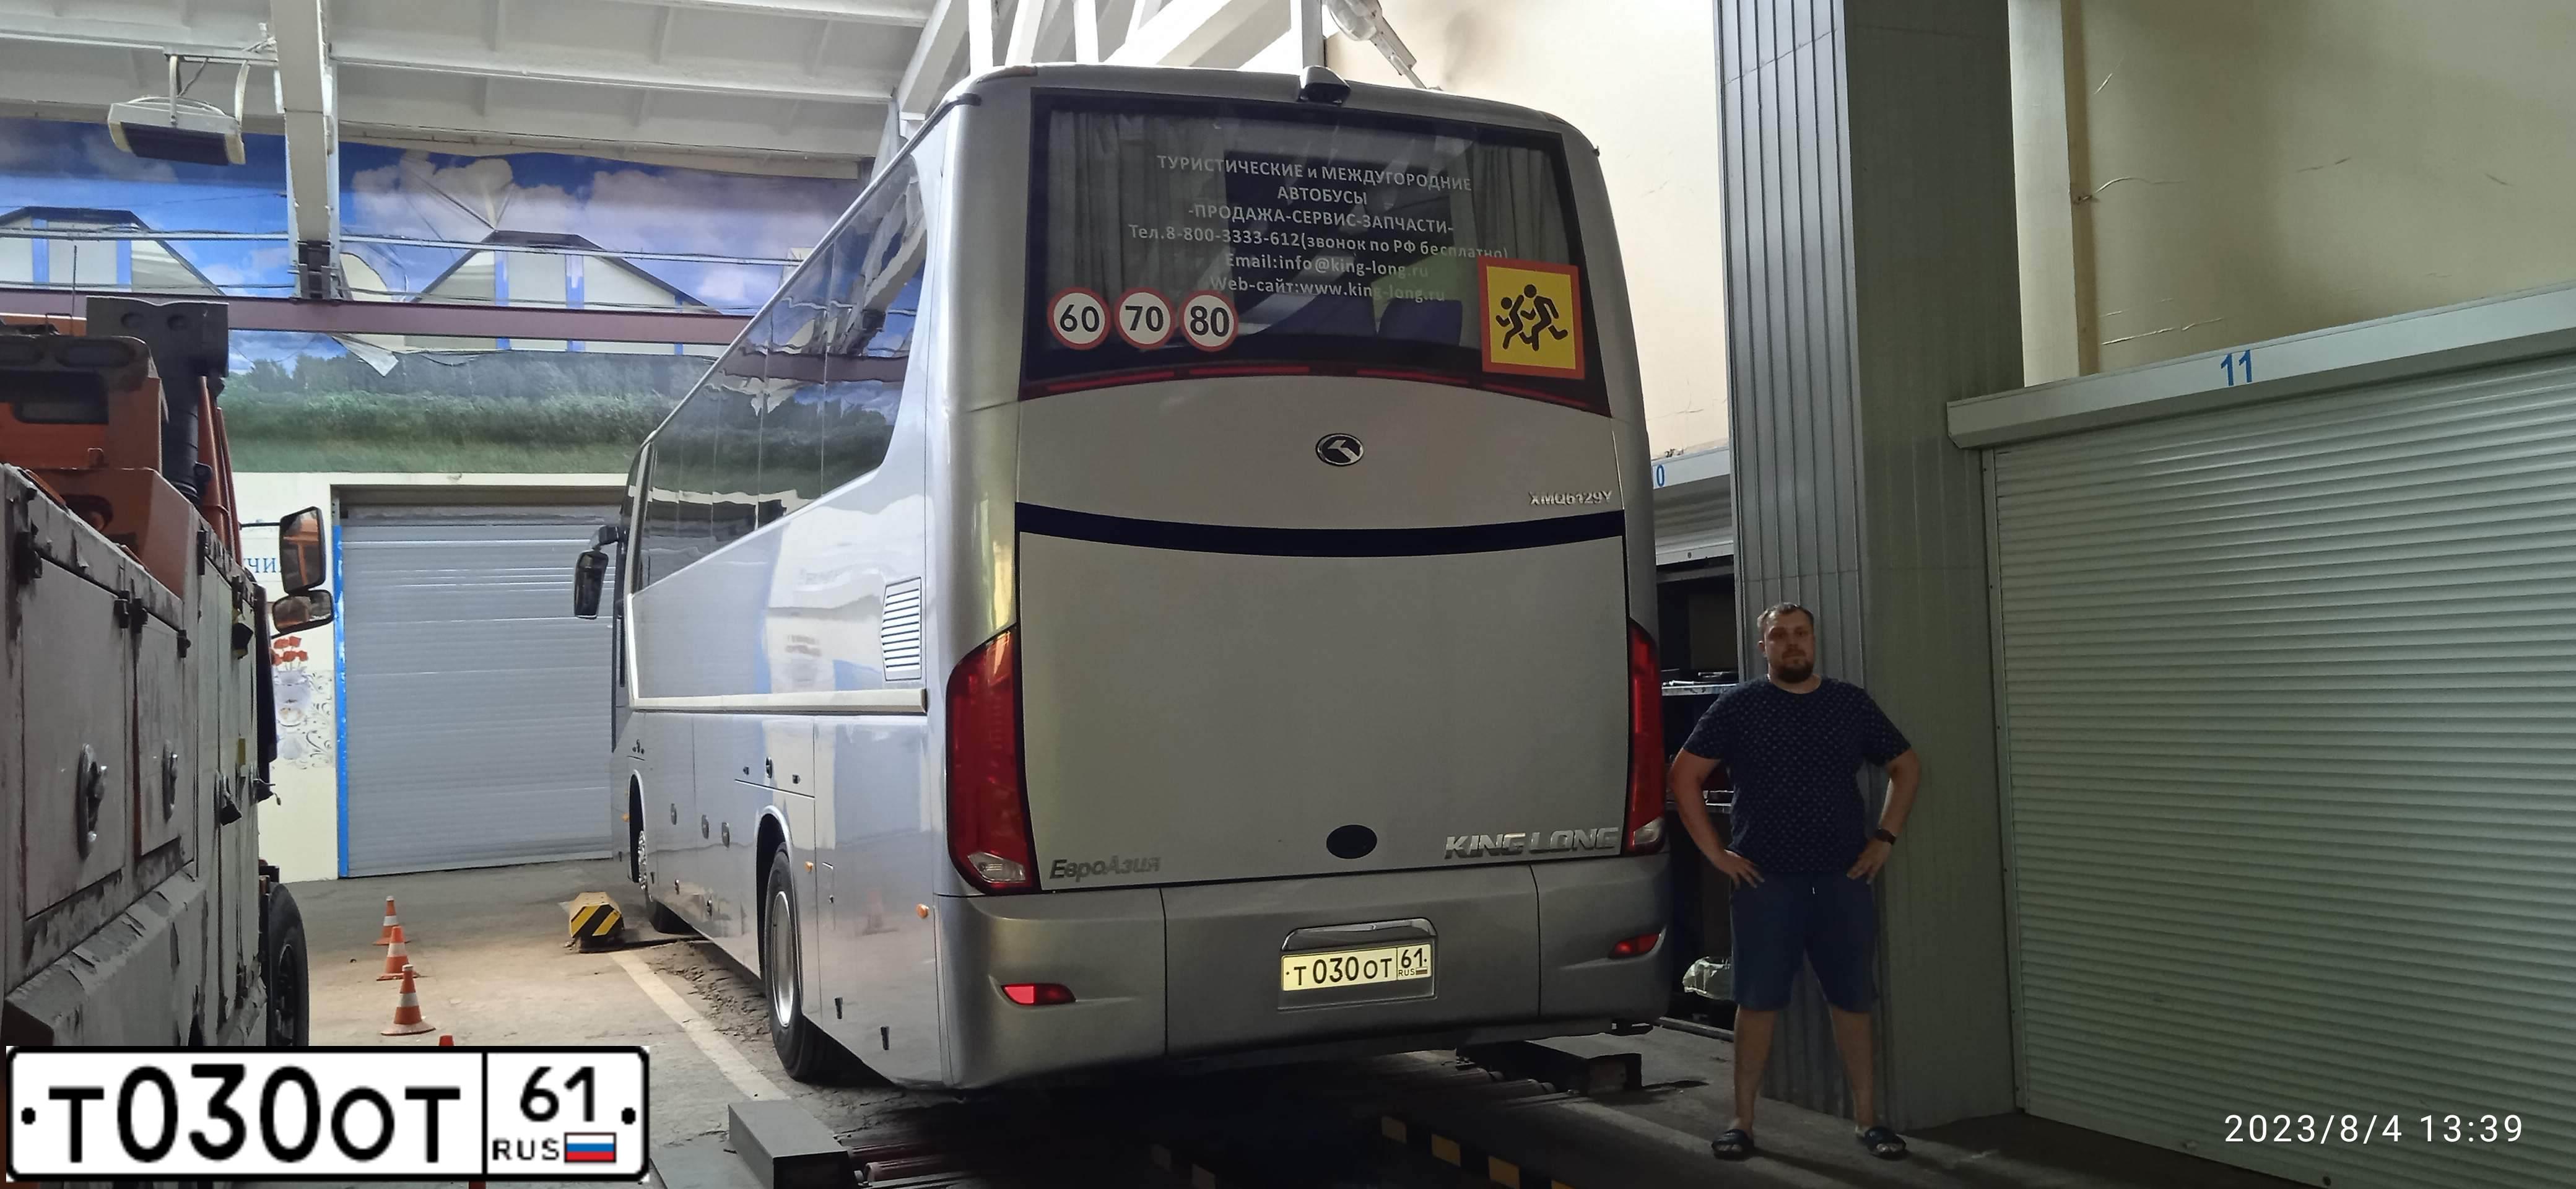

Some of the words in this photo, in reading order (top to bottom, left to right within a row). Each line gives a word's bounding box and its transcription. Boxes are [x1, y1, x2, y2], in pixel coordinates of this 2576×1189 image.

[1156, 155, 1303, 178] ТУРИСТИЧЕСКИЕ
[1307, 168, 1318, 178] и
[1321, 166, 1473, 191] МЕЖДУГОРОДНИЕ
[1277, 186, 1368, 205] АВТОБУСЫ
[1370, 241, 1390, 252] по
[1394, 240, 1416, 253] РФ
[1060, 303, 1100, 333] 60
[1125, 305, 1164, 332] 70
[1190, 305, 1229, 338] 80
[2221, 349, 2252, 386] 11
[1655, 464, 1665, 487] 0
[1528, 490, 1612, 505] XMQ6129Y
[243, 557, 281, 573] ЧИ
[1445, 832, 1526, 859] KING
[1529, 827, 1619, 853] LONG
[1050, 855, 1161, 882] ЕвроАзия
[1401, 947, 1423, 969] 61
[1398, 968, 1416, 976] RUS
